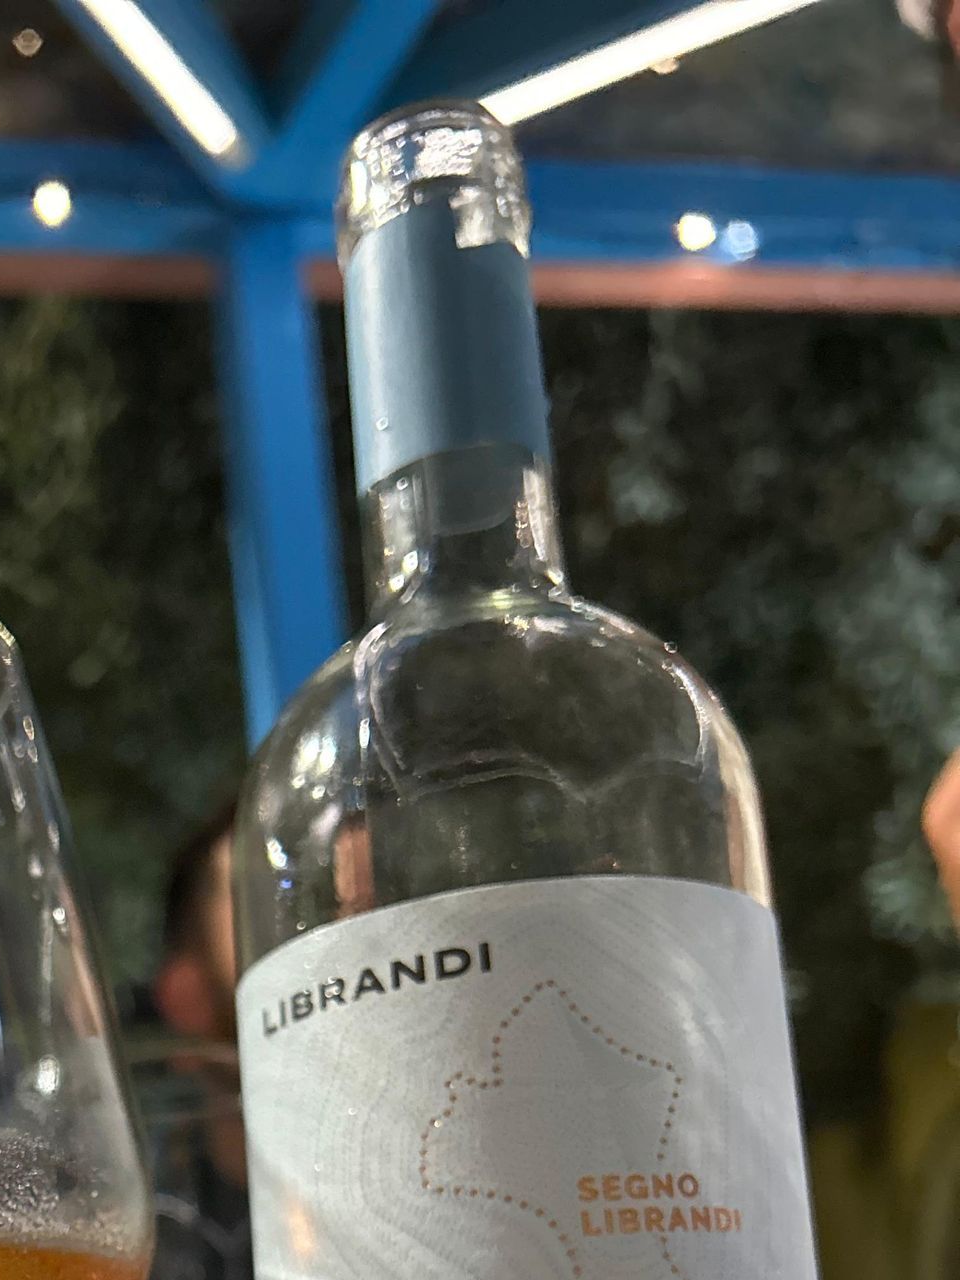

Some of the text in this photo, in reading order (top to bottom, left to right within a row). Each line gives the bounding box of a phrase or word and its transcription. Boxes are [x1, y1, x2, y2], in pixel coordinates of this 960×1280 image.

[261, 942, 494, 1038] LIBRANDI
[577, 1172, 700, 1202] SEGNO
[581, 1205, 742, 1237] LIBRANDI
